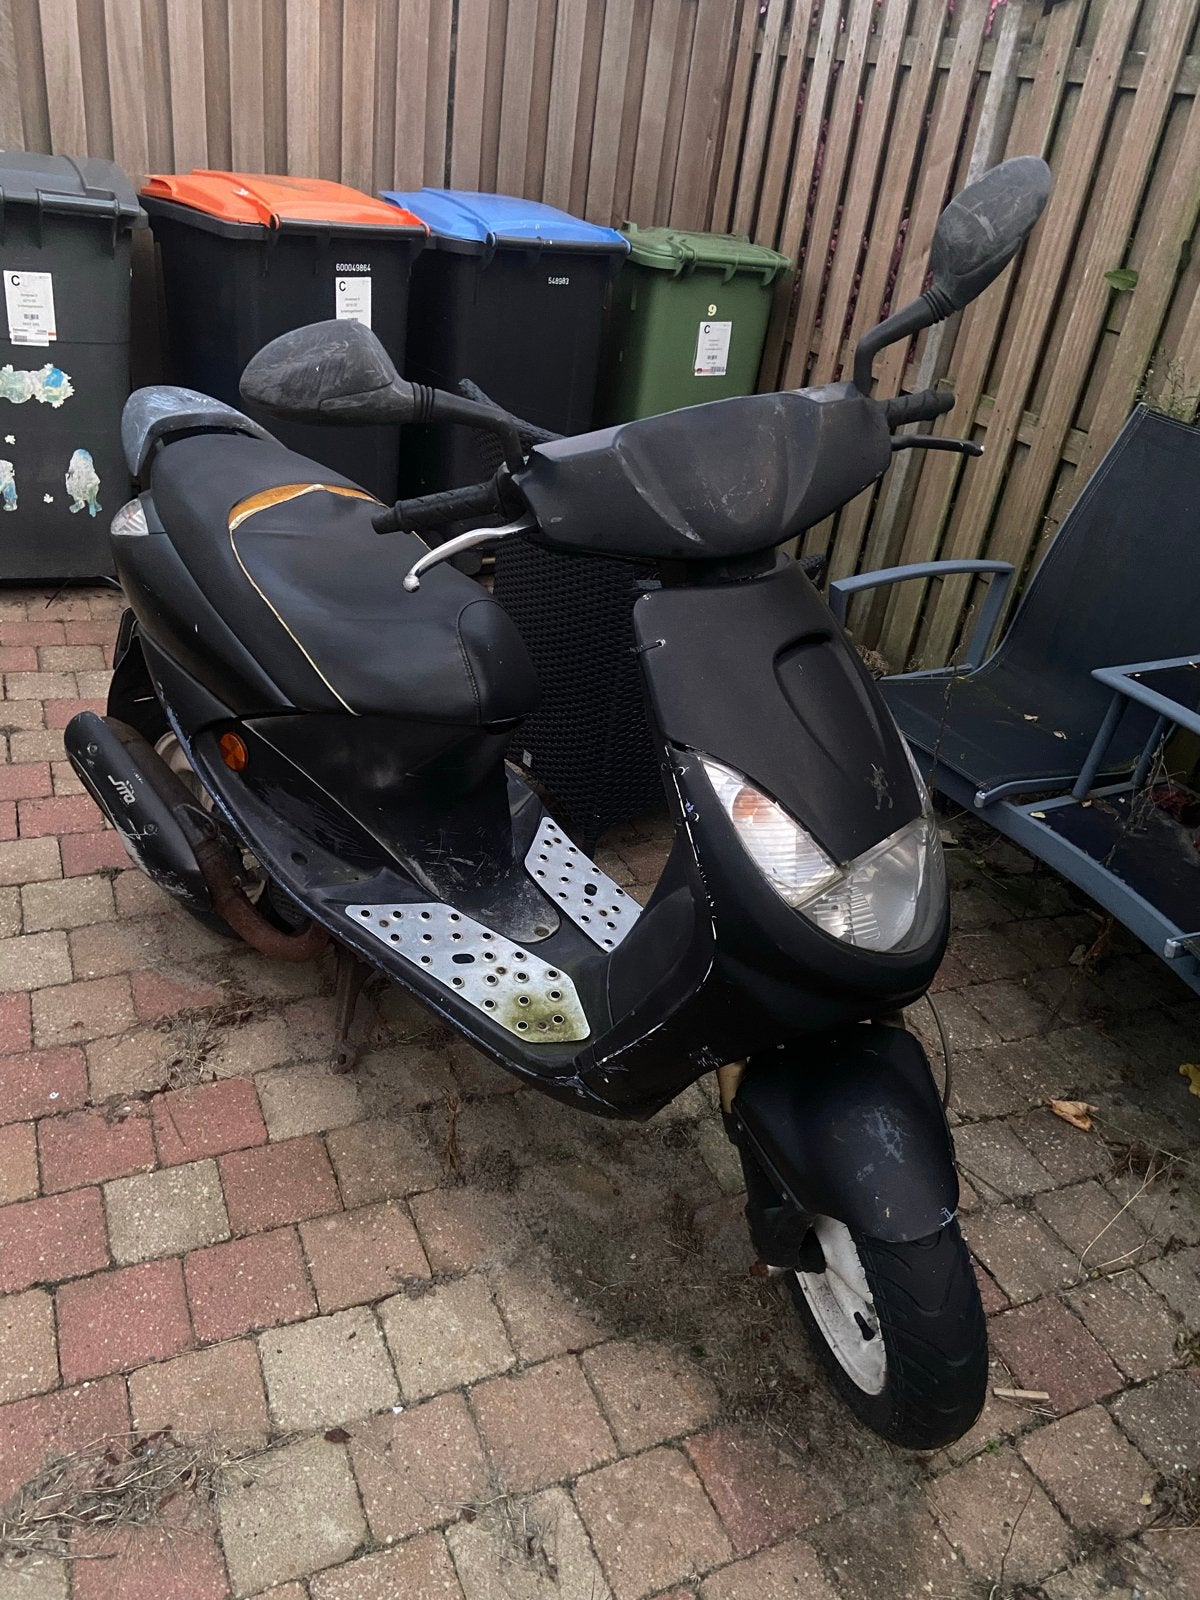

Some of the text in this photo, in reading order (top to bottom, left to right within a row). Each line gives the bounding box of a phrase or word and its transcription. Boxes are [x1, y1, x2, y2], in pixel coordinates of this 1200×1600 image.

[335, 263, 371, 272] 600049864
[11, 274, 21, 287] C
[339, 280, 346, 292] C
[707, 303, 717, 317] 9
[703, 324, 711, 334] C
